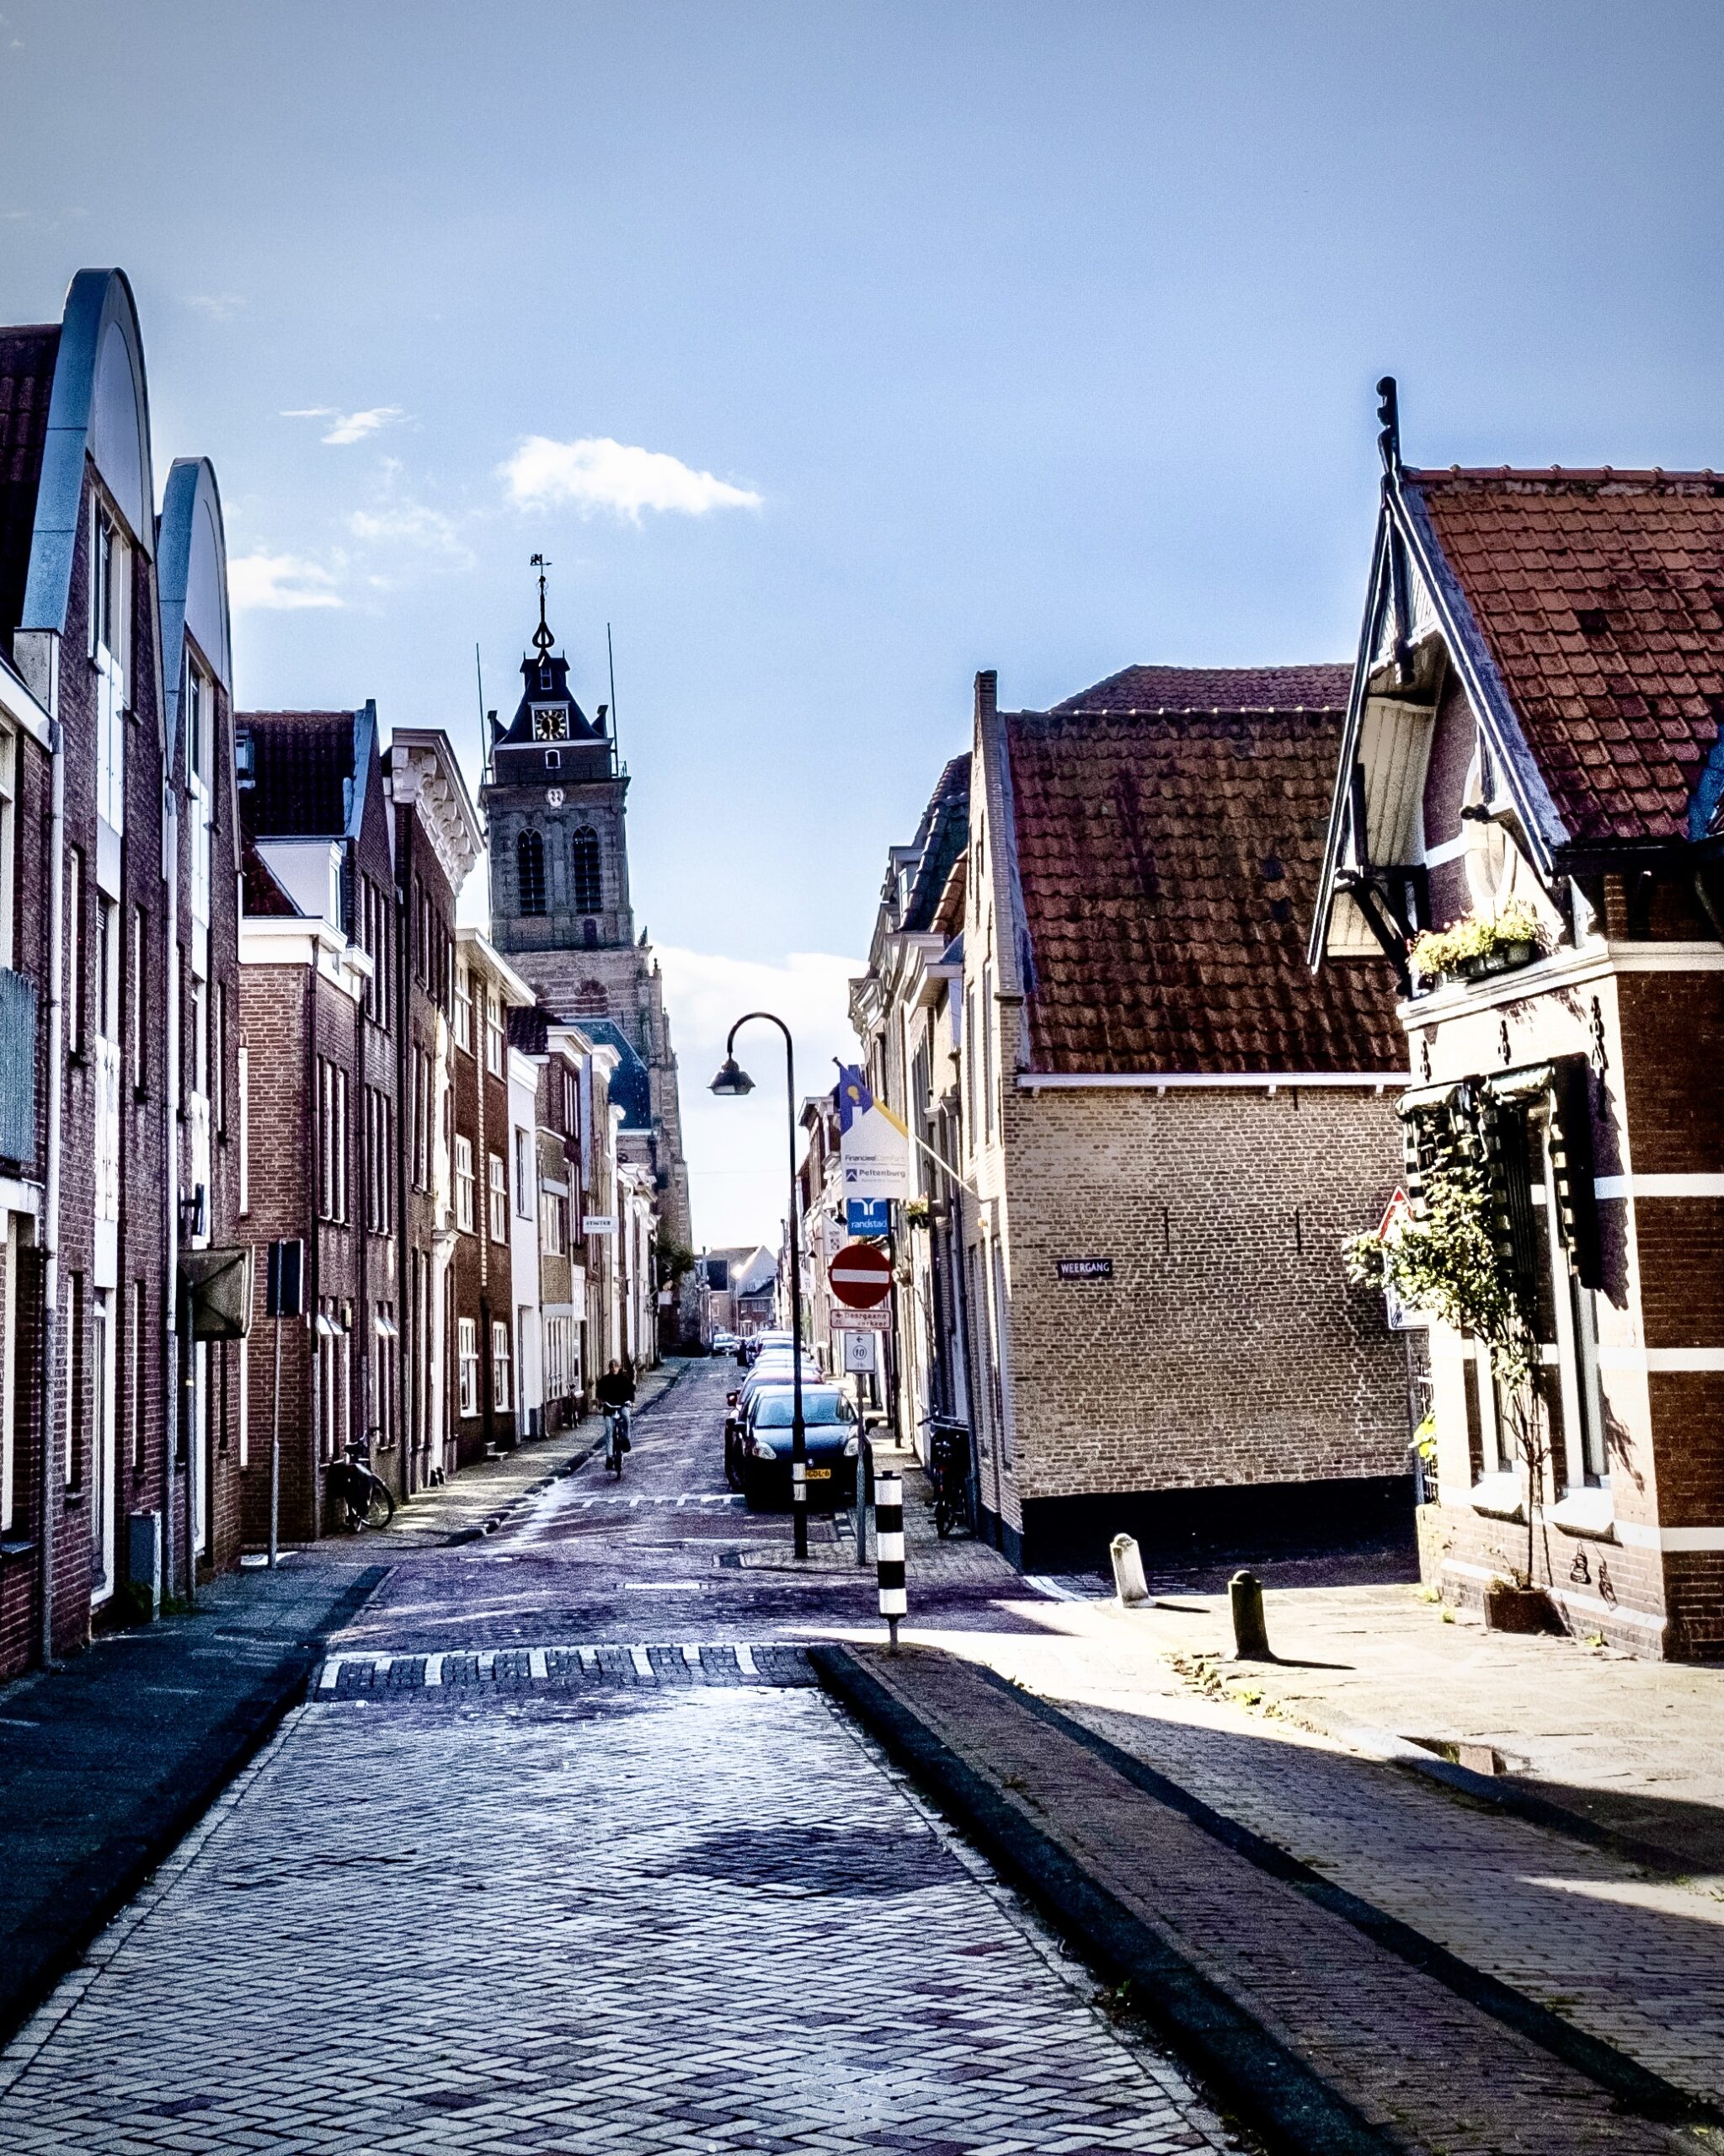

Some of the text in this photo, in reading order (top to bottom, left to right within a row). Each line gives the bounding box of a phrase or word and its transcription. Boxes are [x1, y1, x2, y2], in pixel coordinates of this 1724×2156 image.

[859, 1169, 905, 1178] Peltenburg
[851, 1219, 887, 1228] randstad
[1061, 1262, 1110, 1273] WEERGANG
